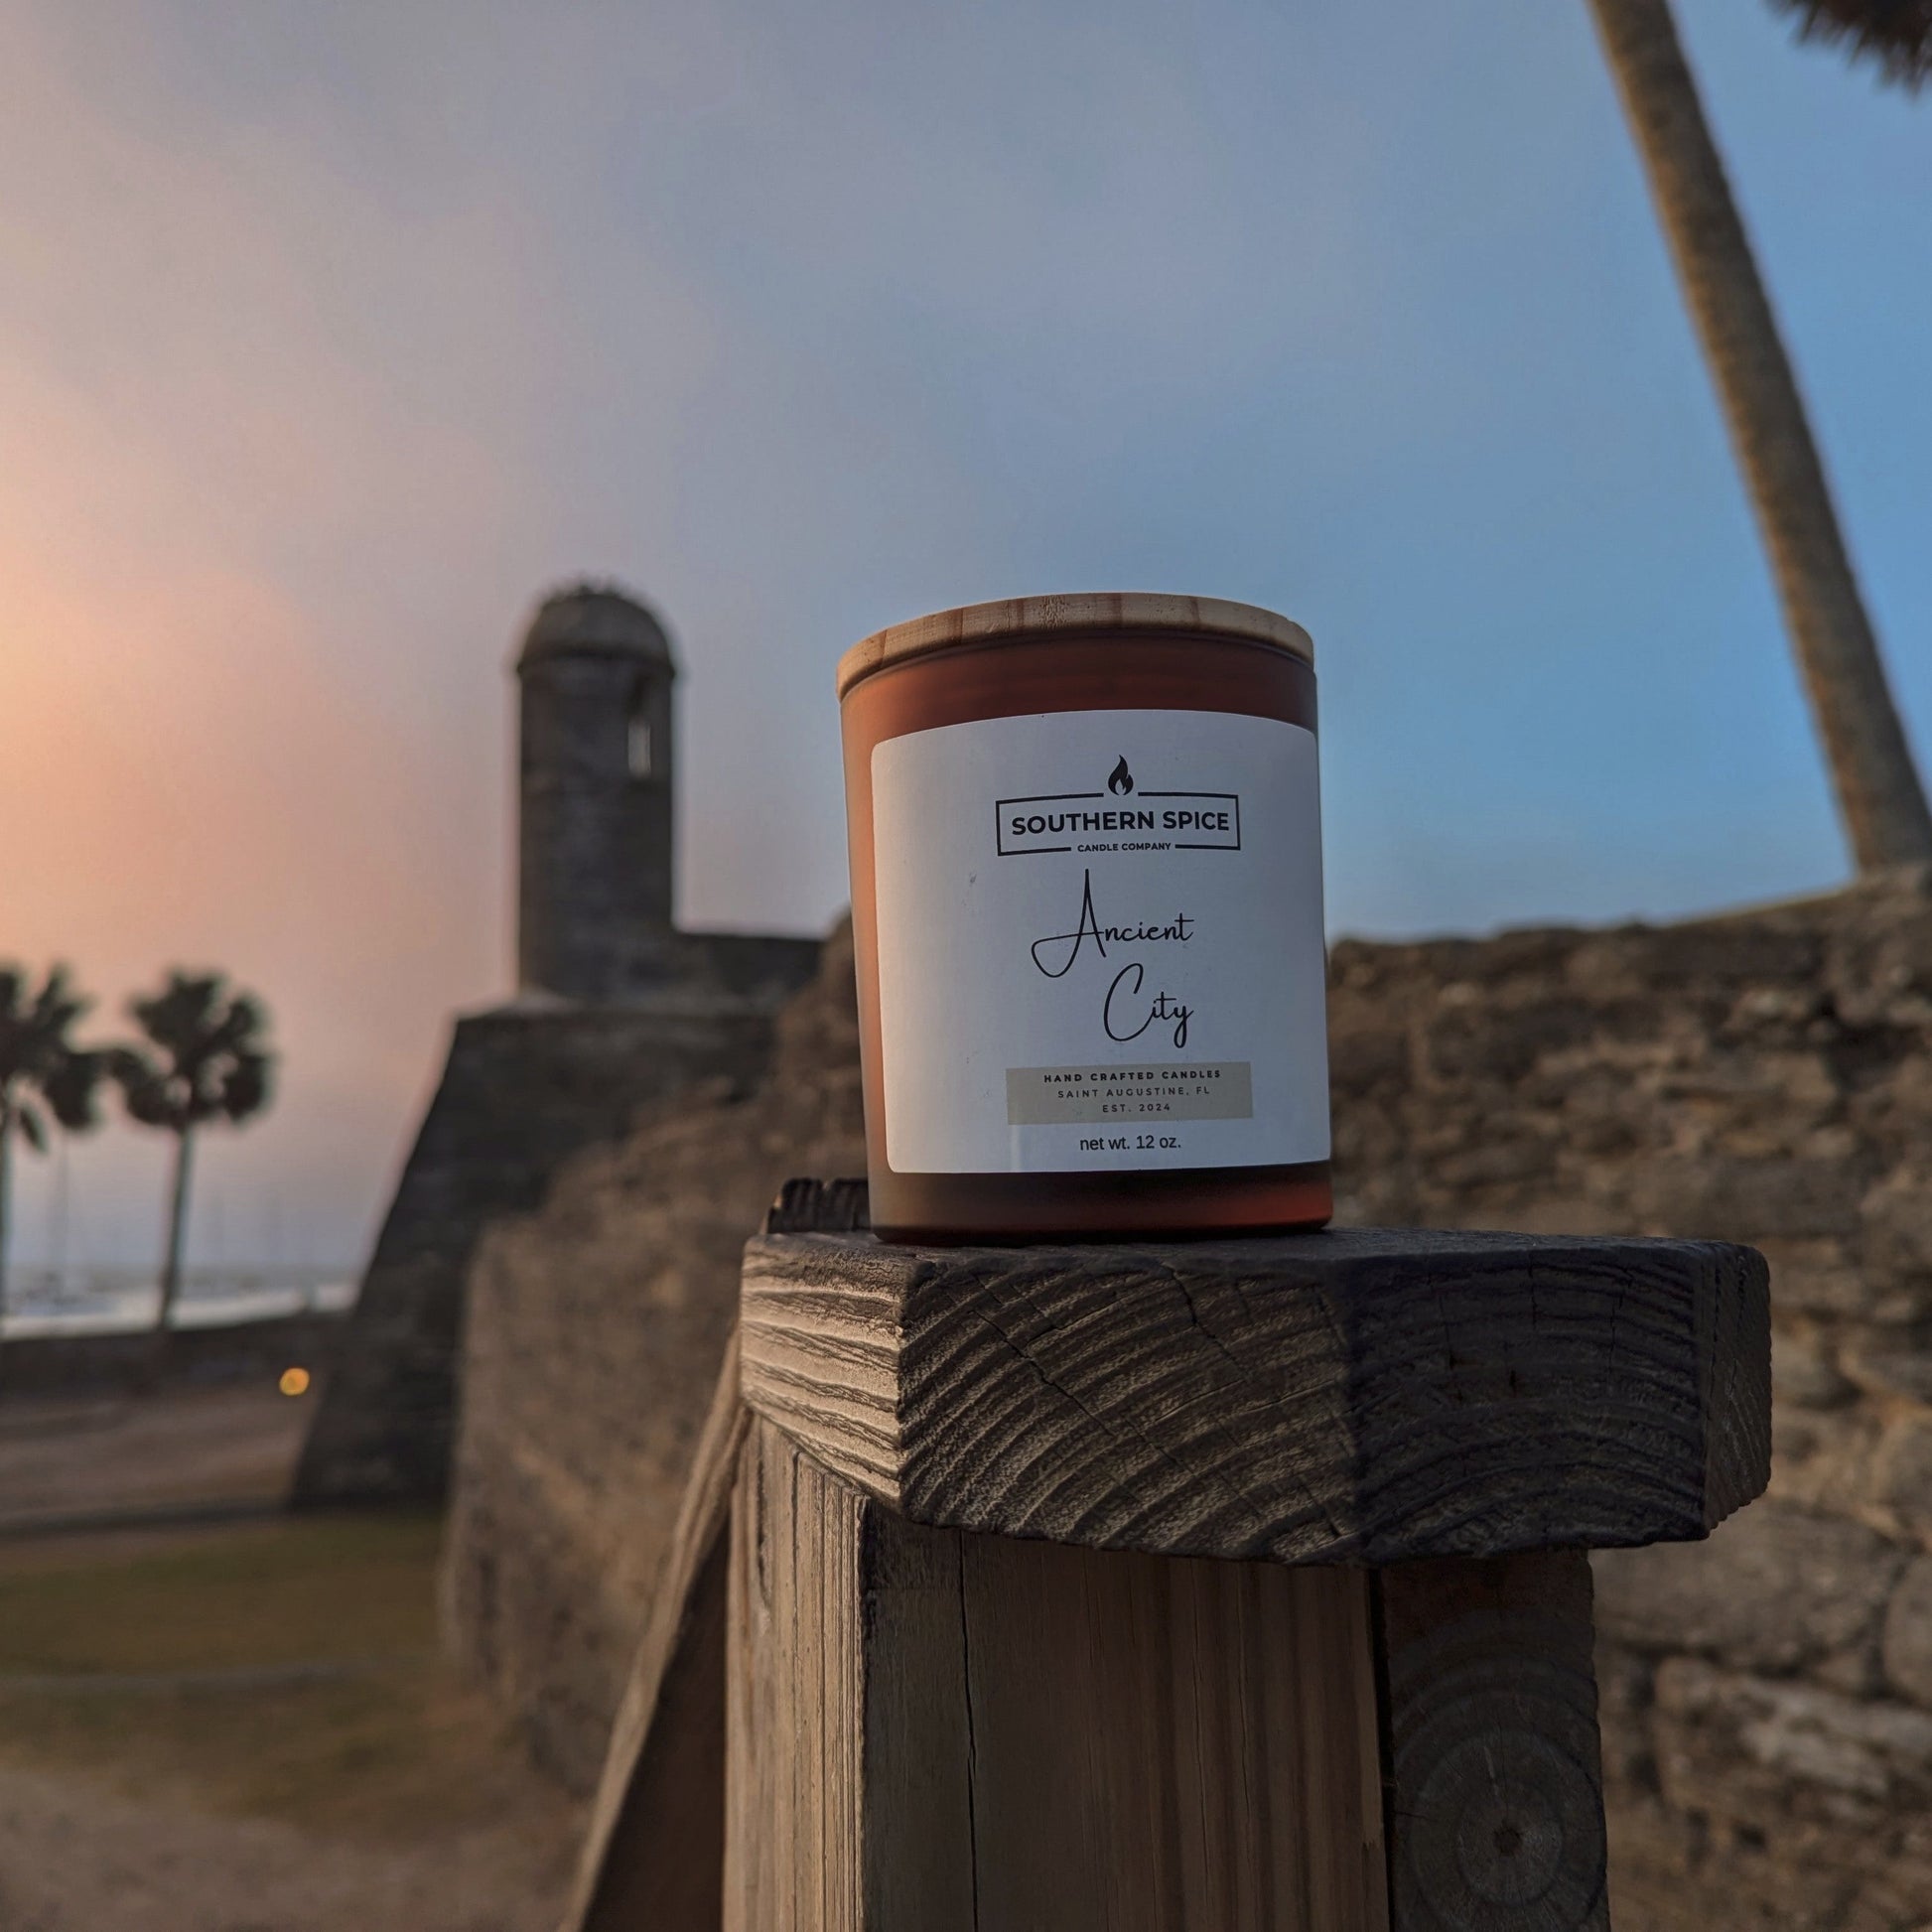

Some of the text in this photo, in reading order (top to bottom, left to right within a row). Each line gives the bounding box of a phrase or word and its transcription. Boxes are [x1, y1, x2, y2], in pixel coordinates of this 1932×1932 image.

[1011, 811, 1230, 836] SOUTHERN SPICE
[1077, 842, 1172, 853] CANDLE COMPANY
[1031, 869, 1194, 978] Ancient
[1103, 962, 1194, 1048] City
[1043, 1069, 1221, 1083] HAND CRAFTED CANDLES
[1057, 1086, 1210, 1098] SAINT AUGUSTINE, FL
[1102, 1103, 1171, 1113] EST. 2024
[1079, 1135, 1181, 1151] net wt. 12 oz.
